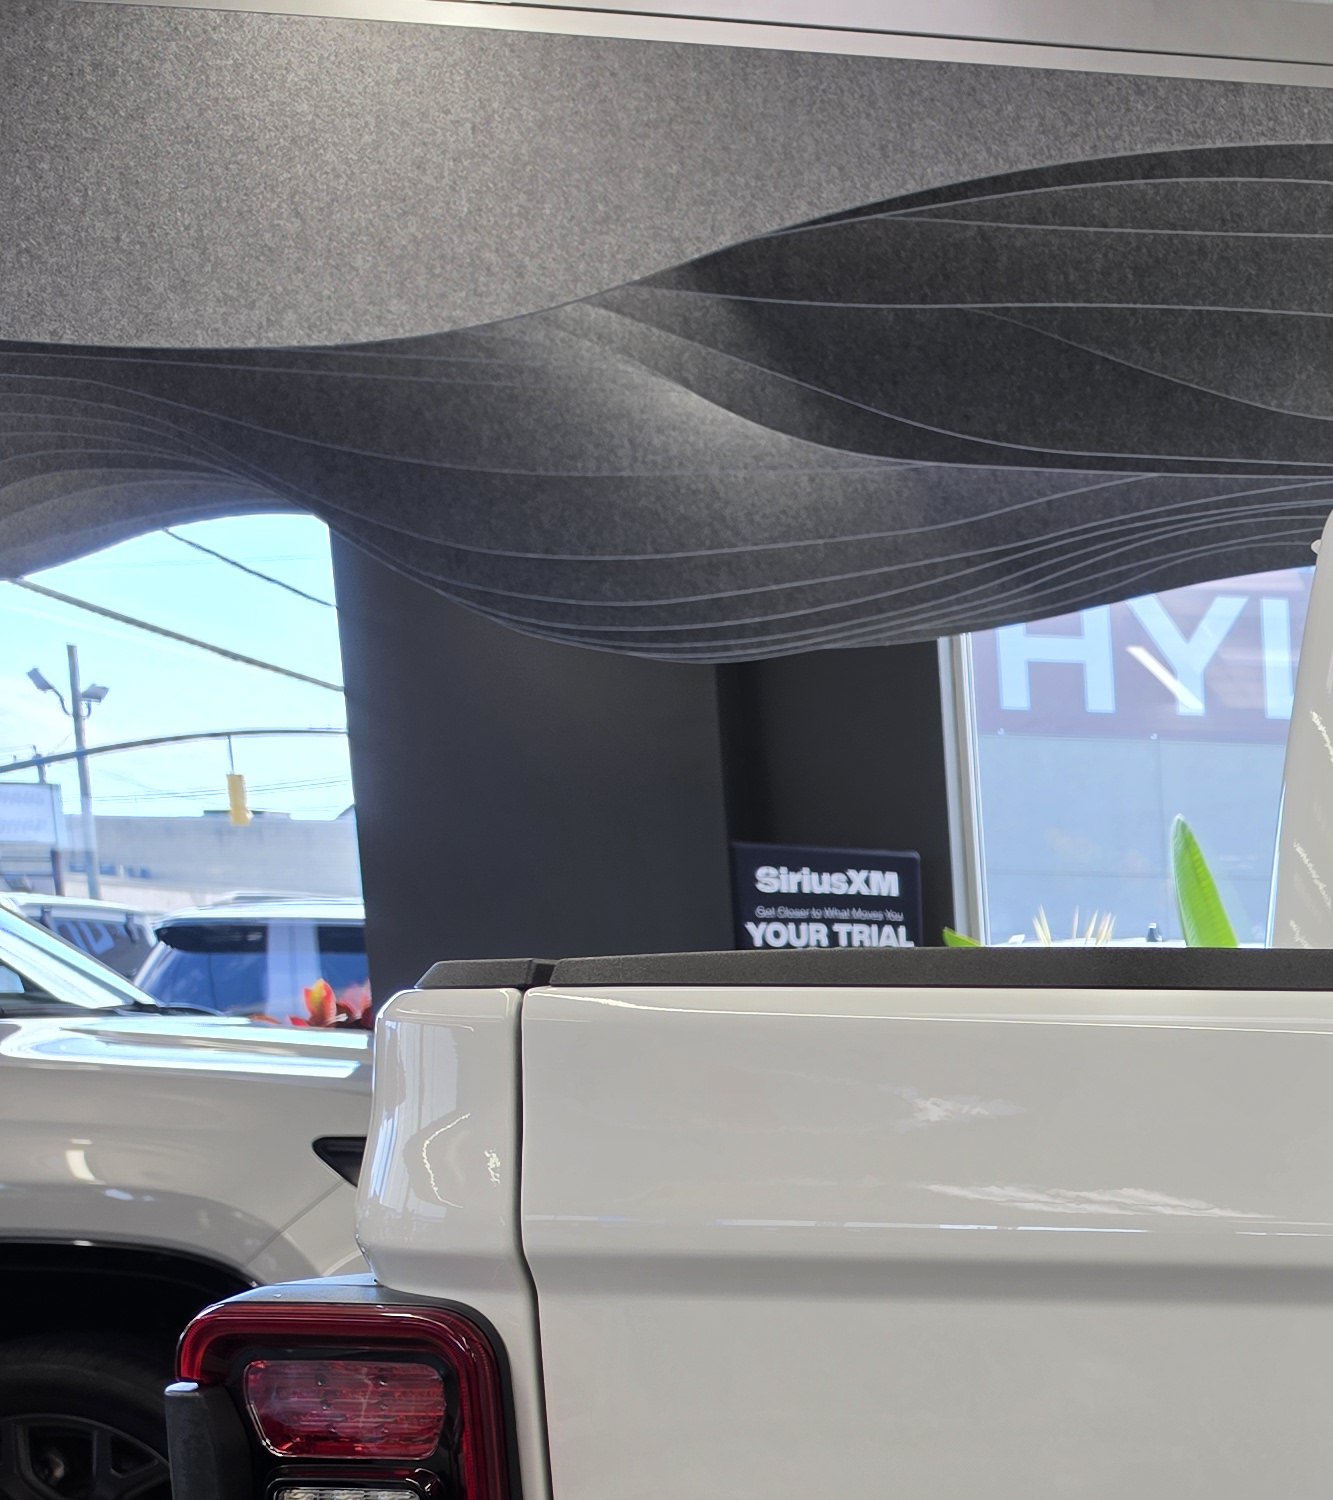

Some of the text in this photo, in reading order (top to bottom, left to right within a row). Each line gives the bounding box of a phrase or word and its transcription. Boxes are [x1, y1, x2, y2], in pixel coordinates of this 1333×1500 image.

[754, 865, 900, 897] SiriusXM
[754, 905, 775, 919] Get
[812, 907, 822, 919] to
[824, 907, 851, 920] What
[744, 921, 915, 948] YOUR TRIAL
